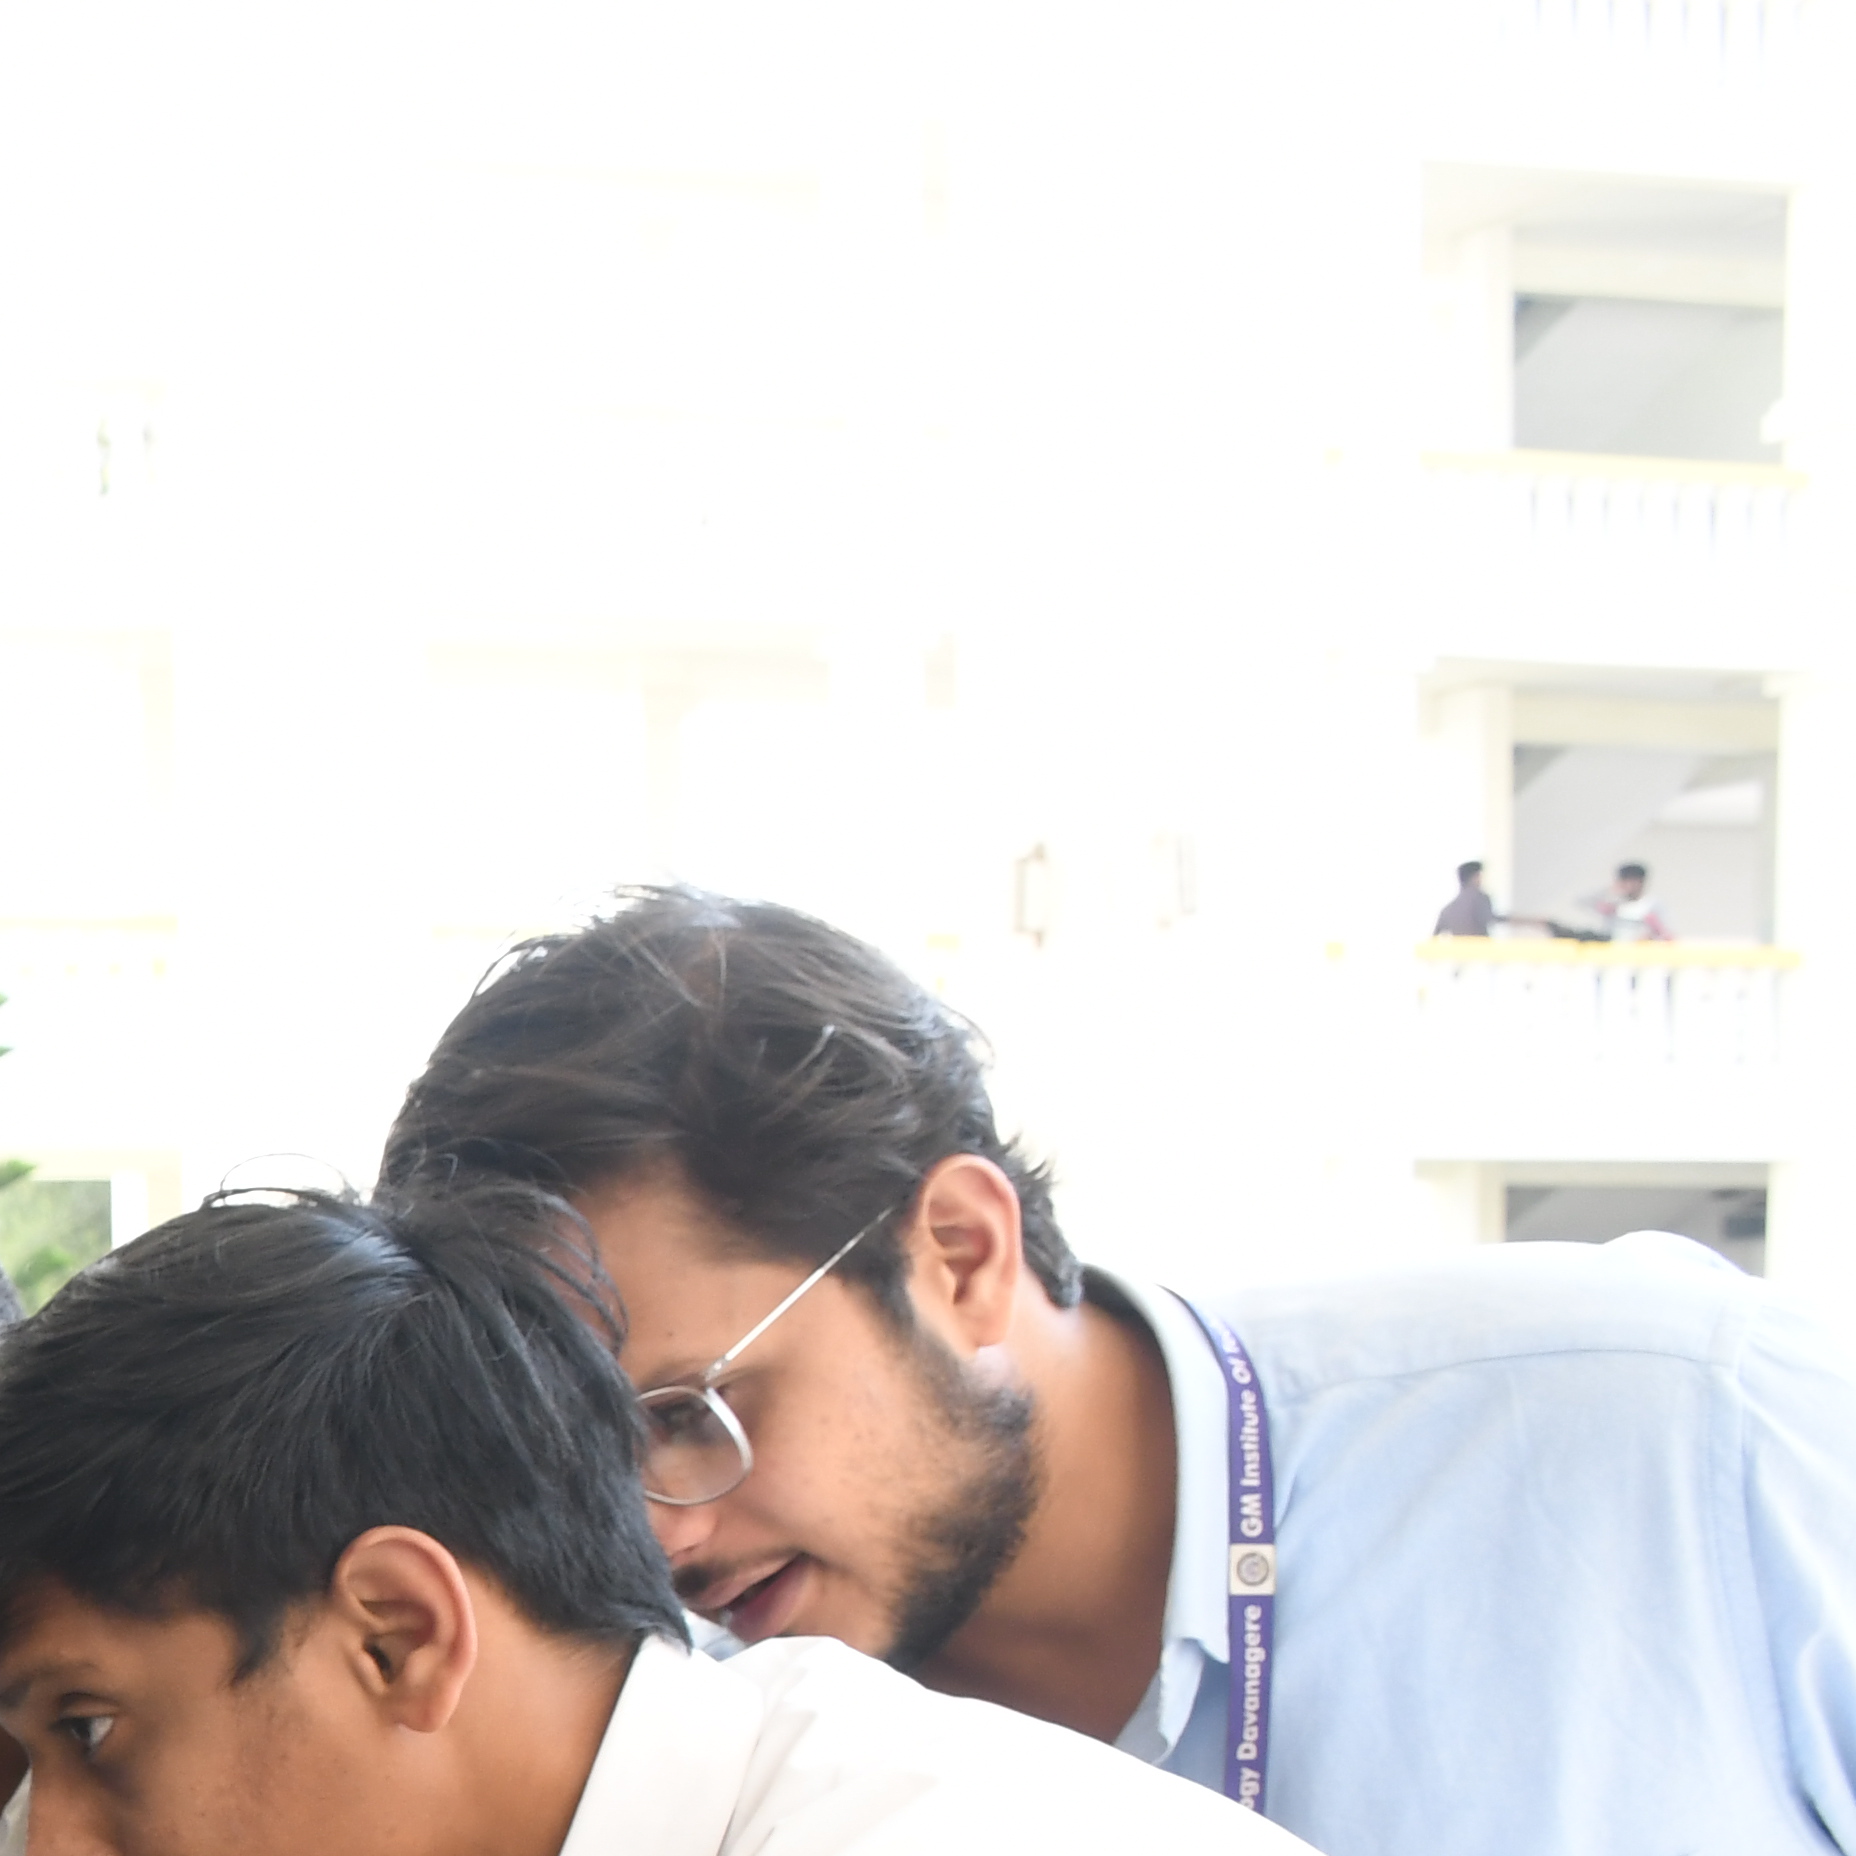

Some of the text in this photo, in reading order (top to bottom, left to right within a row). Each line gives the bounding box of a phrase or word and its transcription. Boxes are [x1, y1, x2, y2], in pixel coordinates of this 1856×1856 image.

[1239, 1389, 1260, 1487] Institute
[1240, 1493, 1264, 1538] GM
[1235, 1604, 1267, 1761] Davanagere
